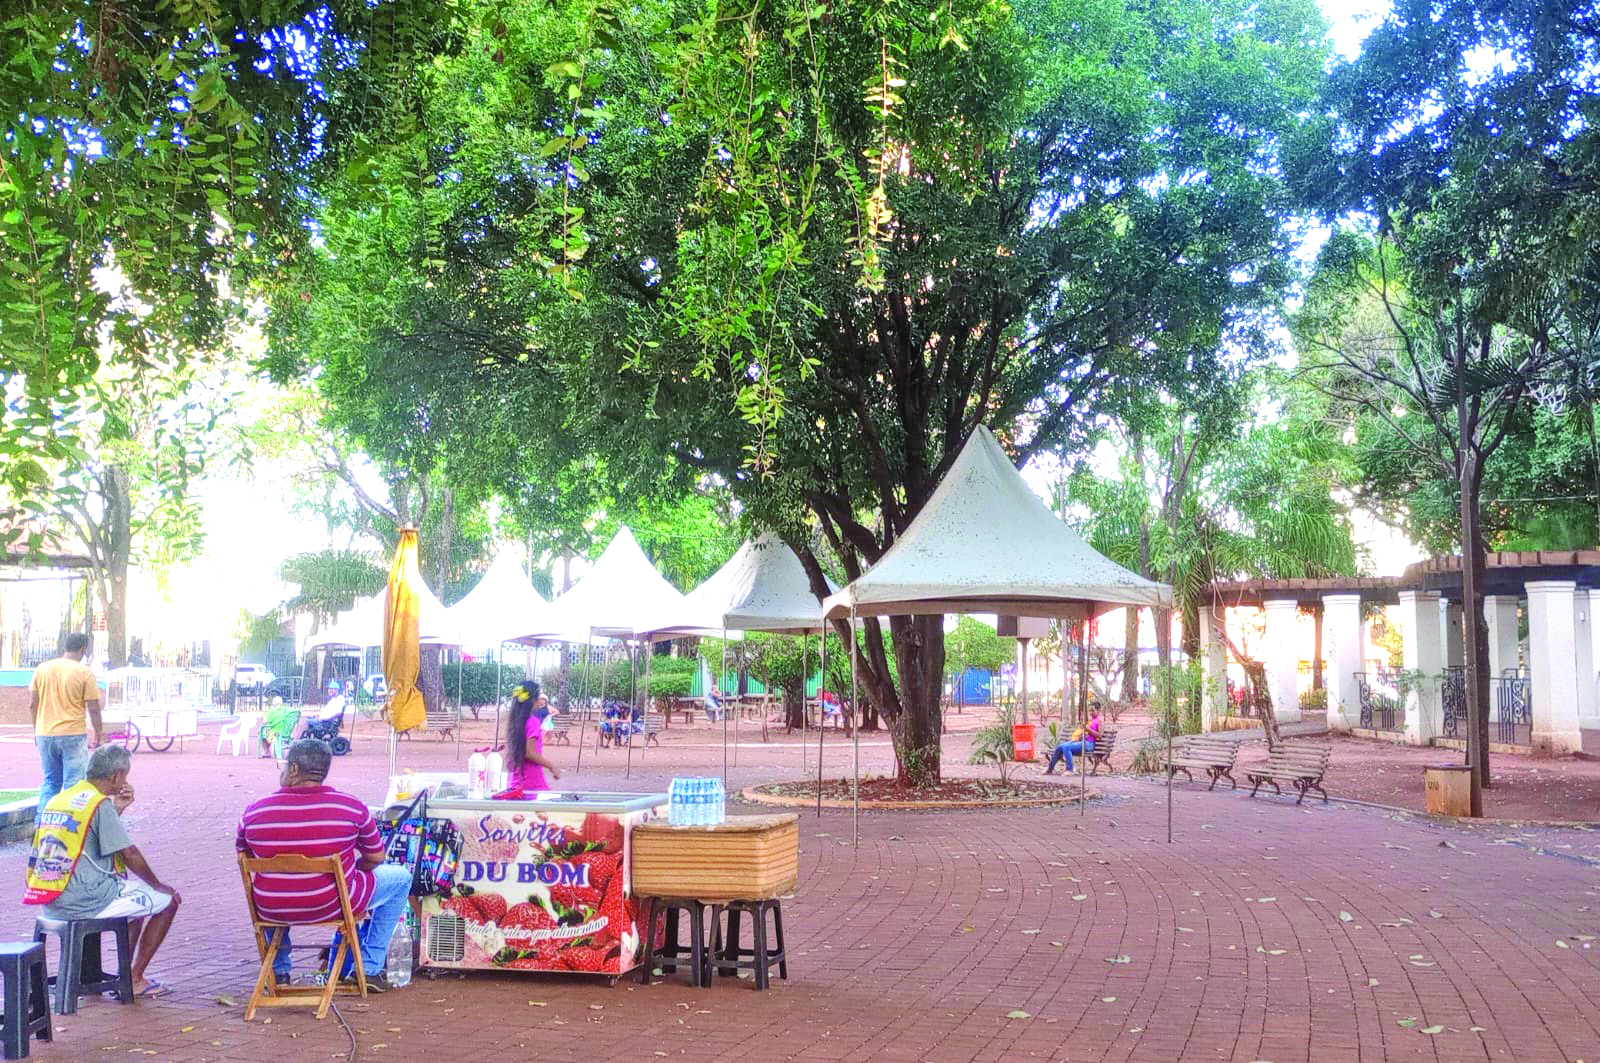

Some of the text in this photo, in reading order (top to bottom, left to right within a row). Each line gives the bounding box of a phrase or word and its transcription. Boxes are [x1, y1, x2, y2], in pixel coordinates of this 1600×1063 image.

[478, 814, 565, 843] Sorvetes
[462, 861, 586, 885] DU BOM
